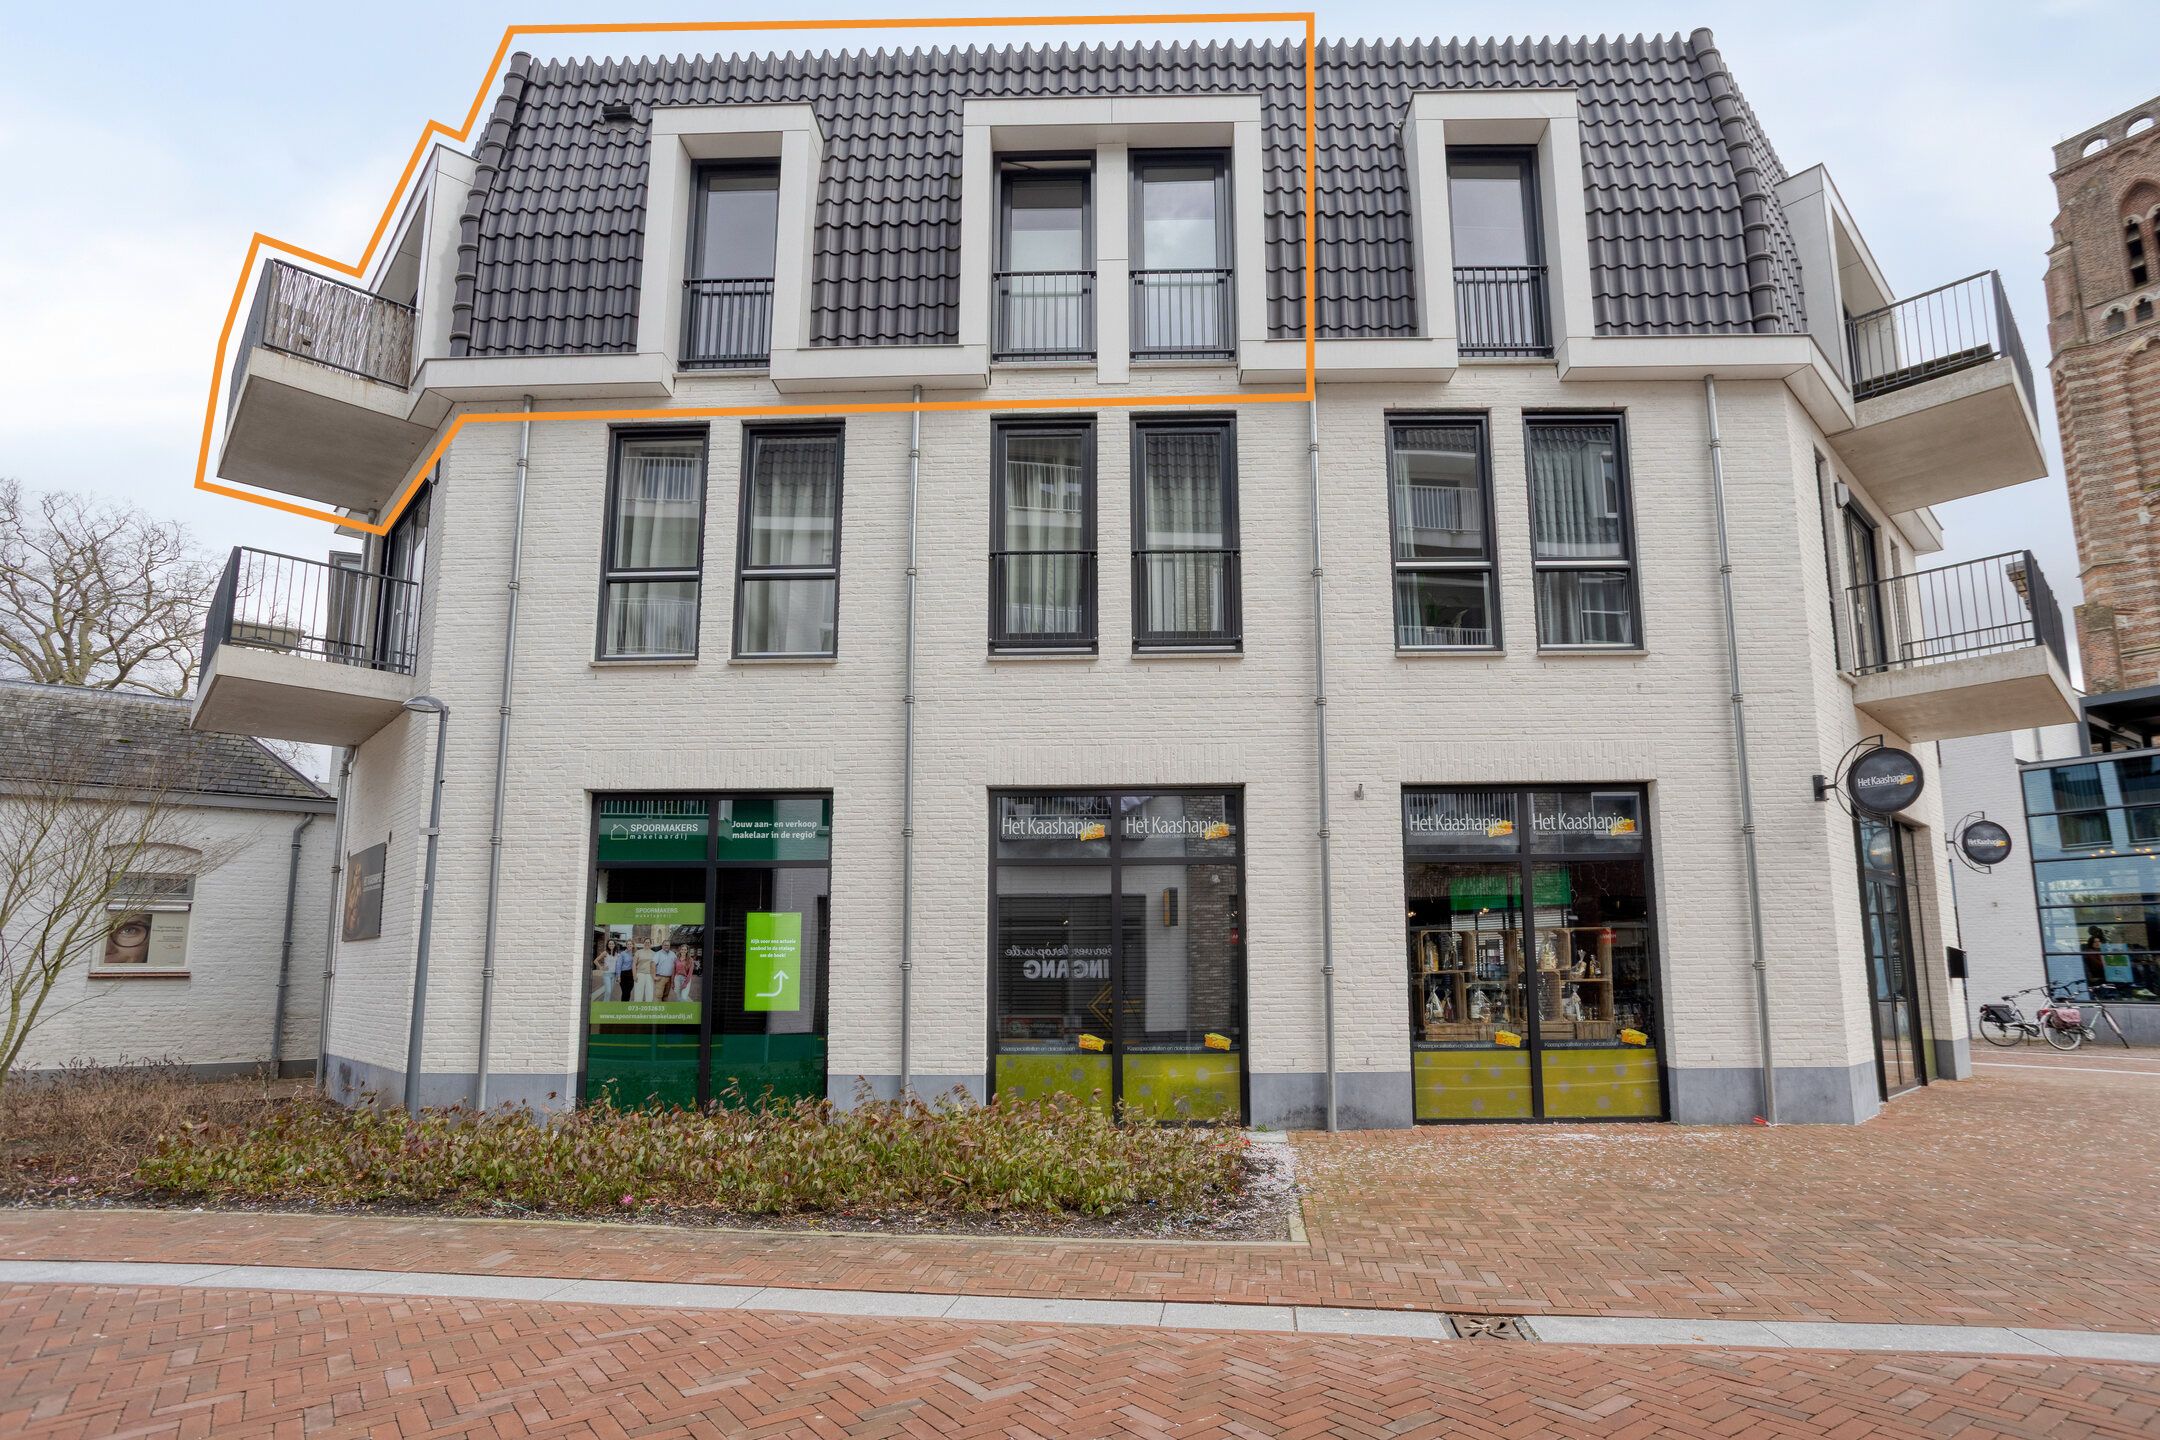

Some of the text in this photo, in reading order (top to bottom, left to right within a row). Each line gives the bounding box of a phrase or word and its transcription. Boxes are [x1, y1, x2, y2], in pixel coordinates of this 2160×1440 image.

[1857, 778, 1871, 787] Het
[630, 823, 698, 832] SPOORMAKERS
[731, 820, 753, 828] Jouw
[785, 820, 817, 830] verkoop
[1002, 816, 1095, 839] Het Kaashapje
[1126, 815, 1219, 838] Het Kaashapje
[1409, 812, 1502, 835] Het Kaashapje
[1533, 811, 1624, 834] Het Kaashapje
[629, 833, 688, 841] makelaardij
[732, 830, 816, 840] makelaar in de regio!
